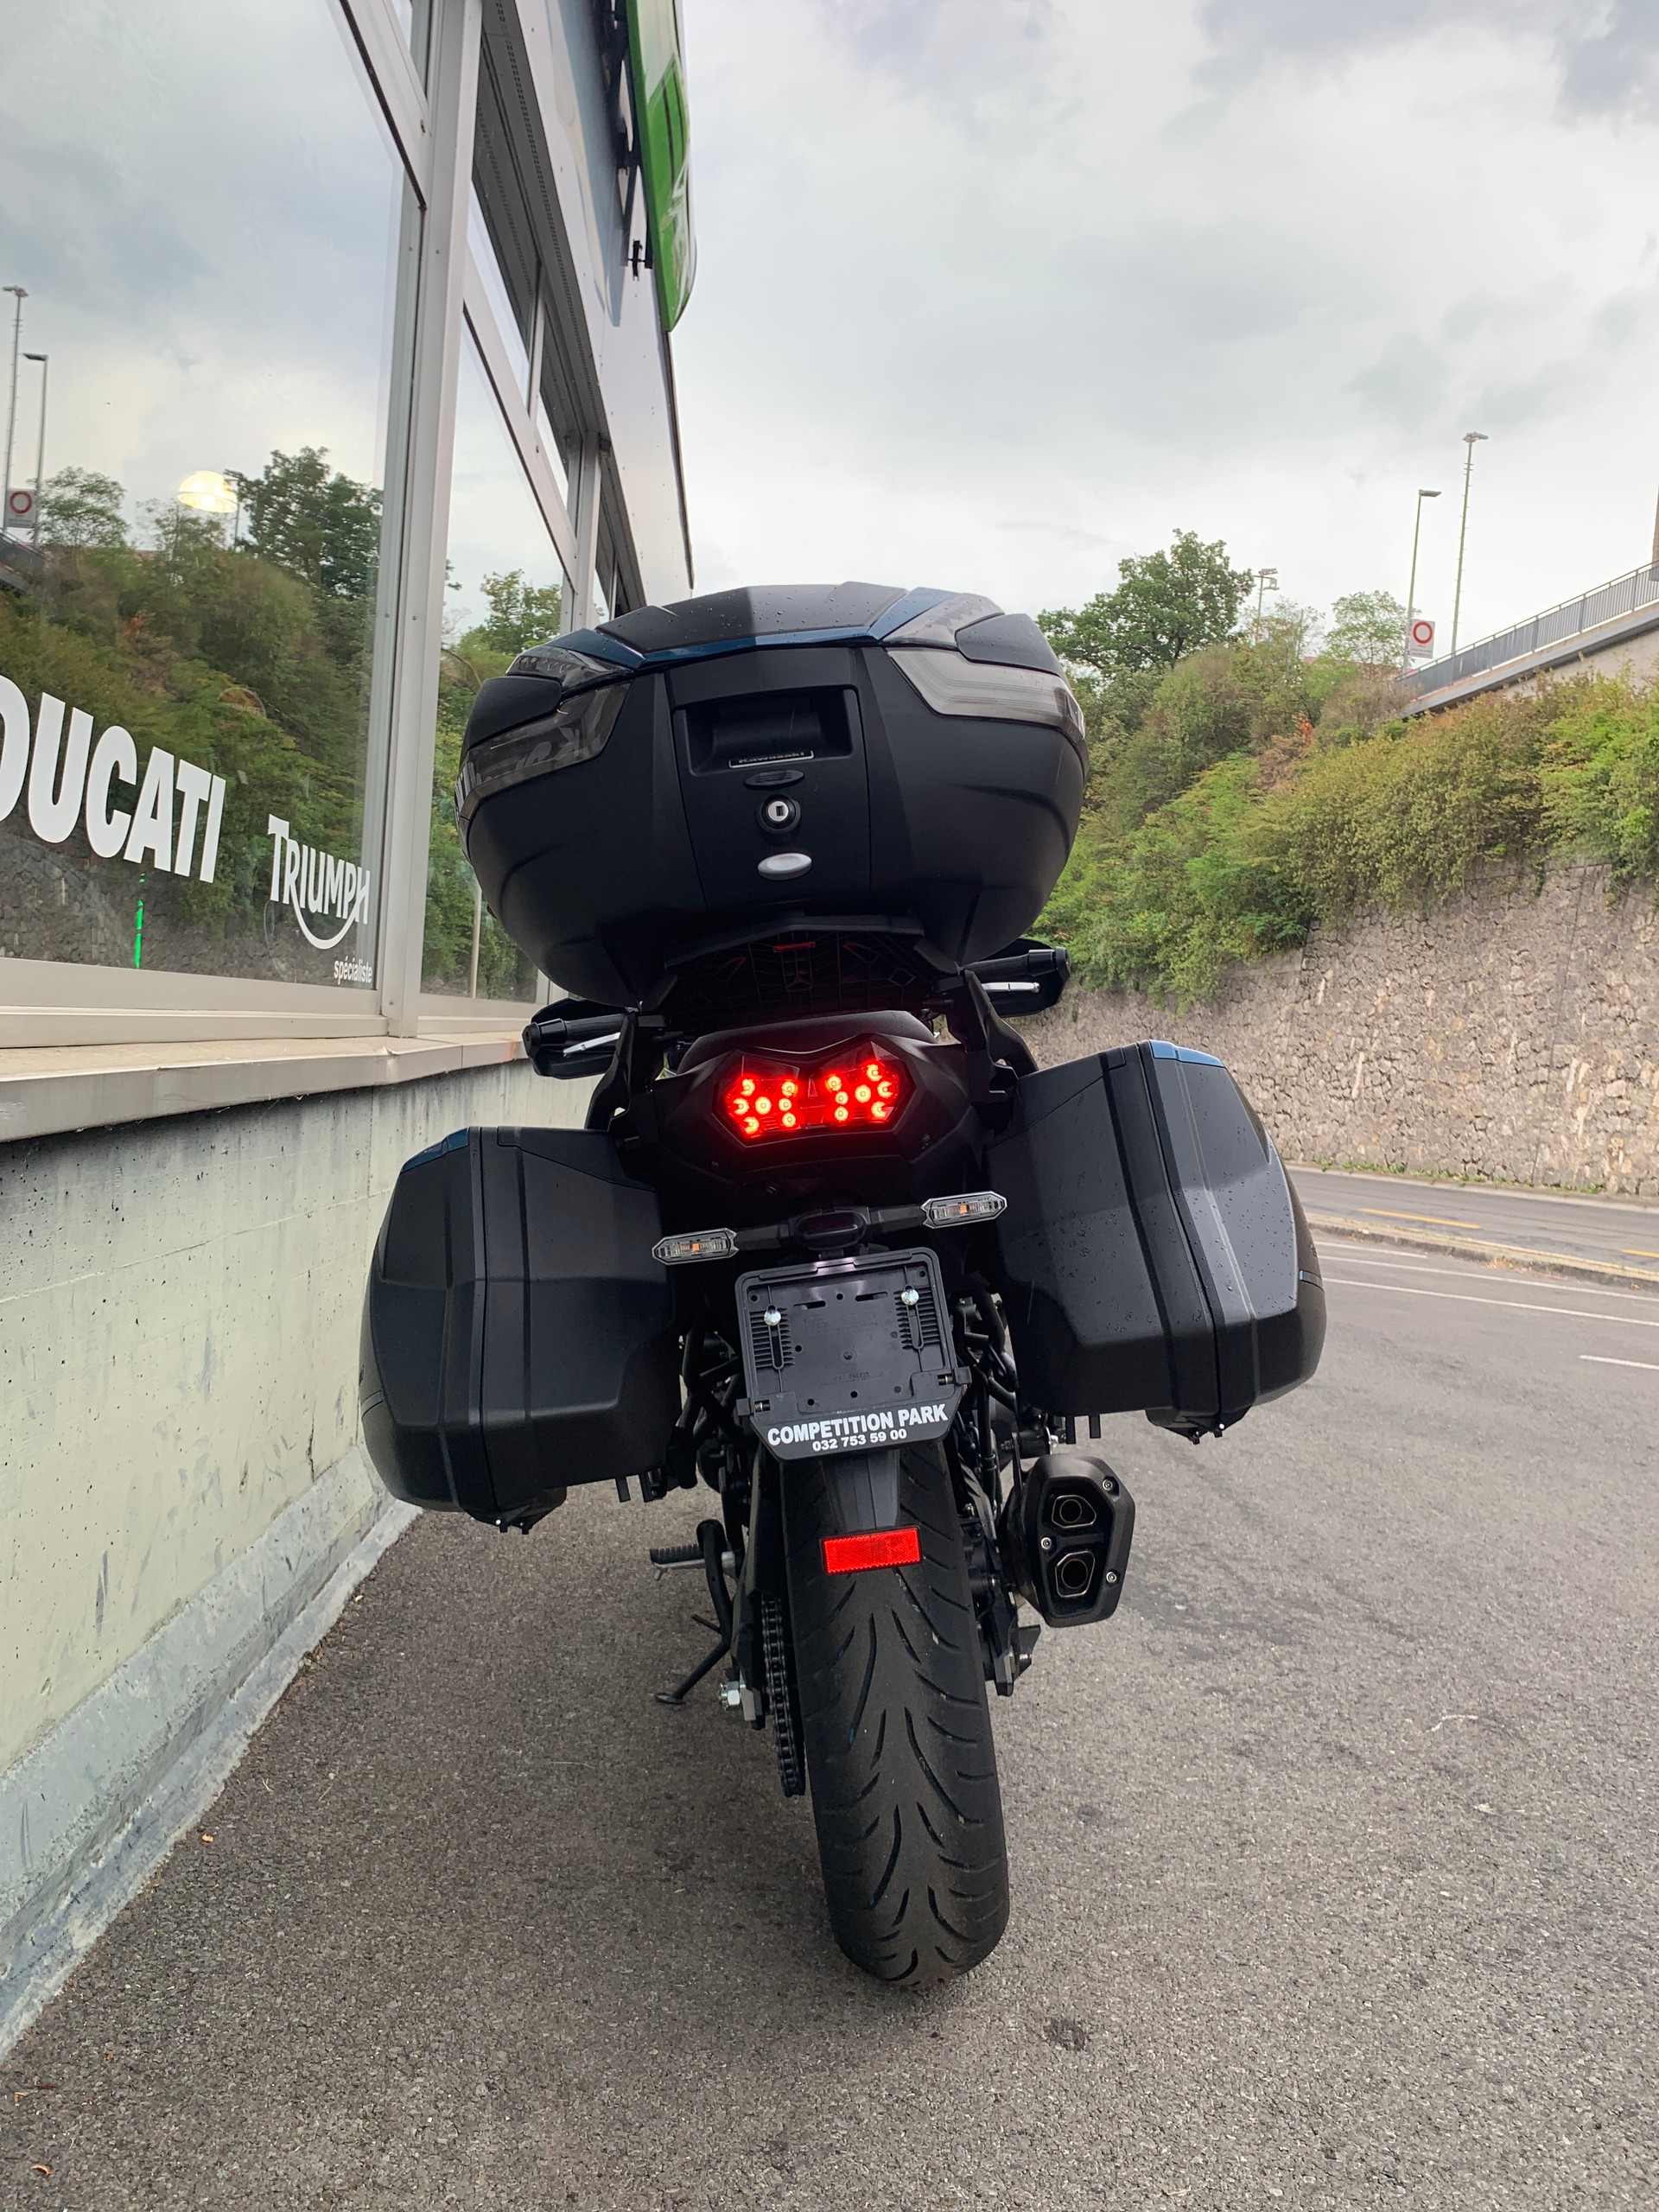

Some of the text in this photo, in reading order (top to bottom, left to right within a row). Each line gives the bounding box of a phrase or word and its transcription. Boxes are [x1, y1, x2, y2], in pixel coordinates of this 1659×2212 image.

[267, 814, 371, 950] TRIUMPH
[334, 957, 372, 984] spécialiste
[767, 1403, 949, 1446] COMPETITION PARK
[812, 1428, 907, 1452] 032 753 59 00
